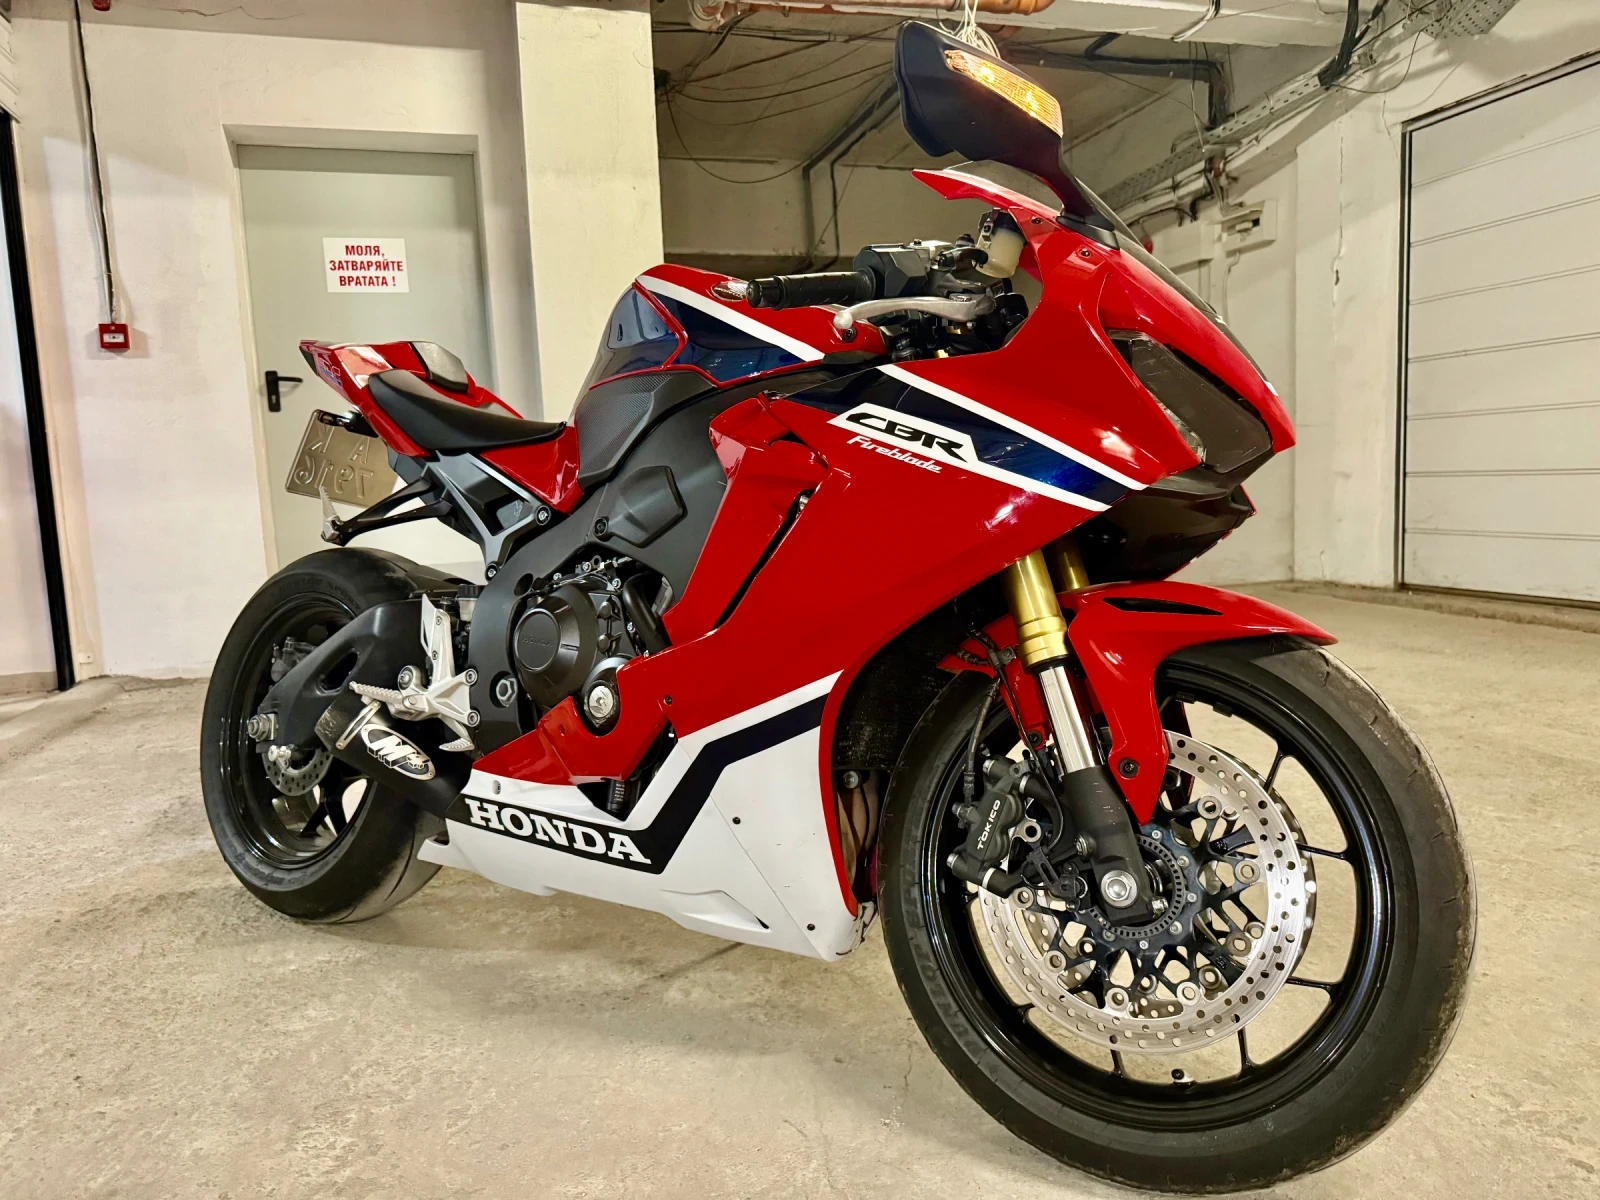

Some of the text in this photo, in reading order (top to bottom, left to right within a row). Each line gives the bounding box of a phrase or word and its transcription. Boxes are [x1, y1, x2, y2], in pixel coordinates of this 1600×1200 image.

[329, 258, 404, 272] ЗАТВАРЯЙТЕ
[344, 244, 385, 258] МОЛЯ,
[339, 275, 389, 287] ВРАТАТА
[845, 412, 968, 463] CBR
[846, 435, 943, 474] Fireblade
[464, 798, 652, 864] HONDA
[977, 799, 1001, 850] TOKICO
